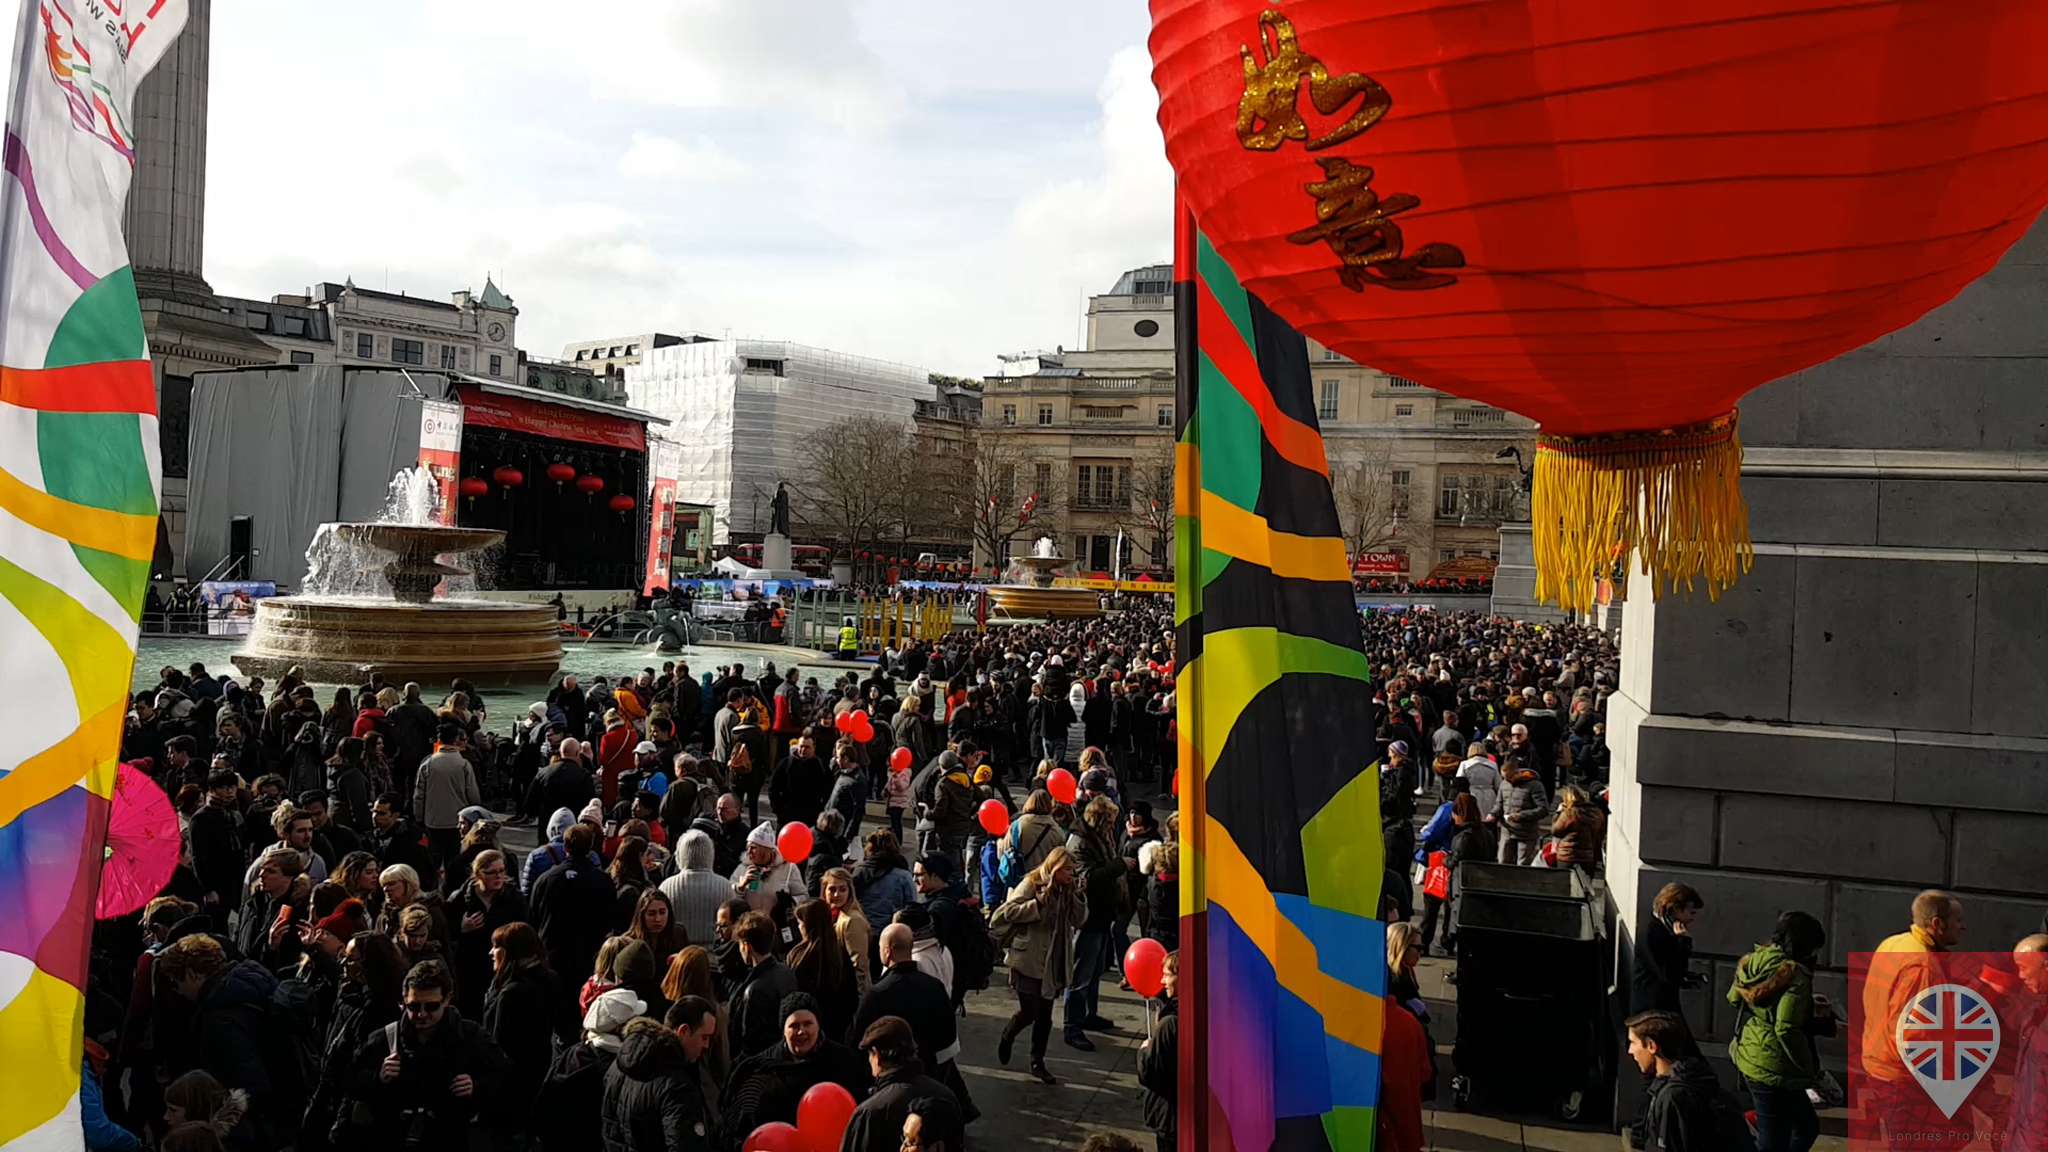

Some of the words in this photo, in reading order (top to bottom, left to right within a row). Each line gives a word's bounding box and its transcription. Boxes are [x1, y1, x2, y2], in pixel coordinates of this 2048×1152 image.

[524, 415, 548, 429] Happy
[549, 419, 572, 431] Chinese
[573, 423, 585, 433] New
[586, 425, 599, 436] Year
